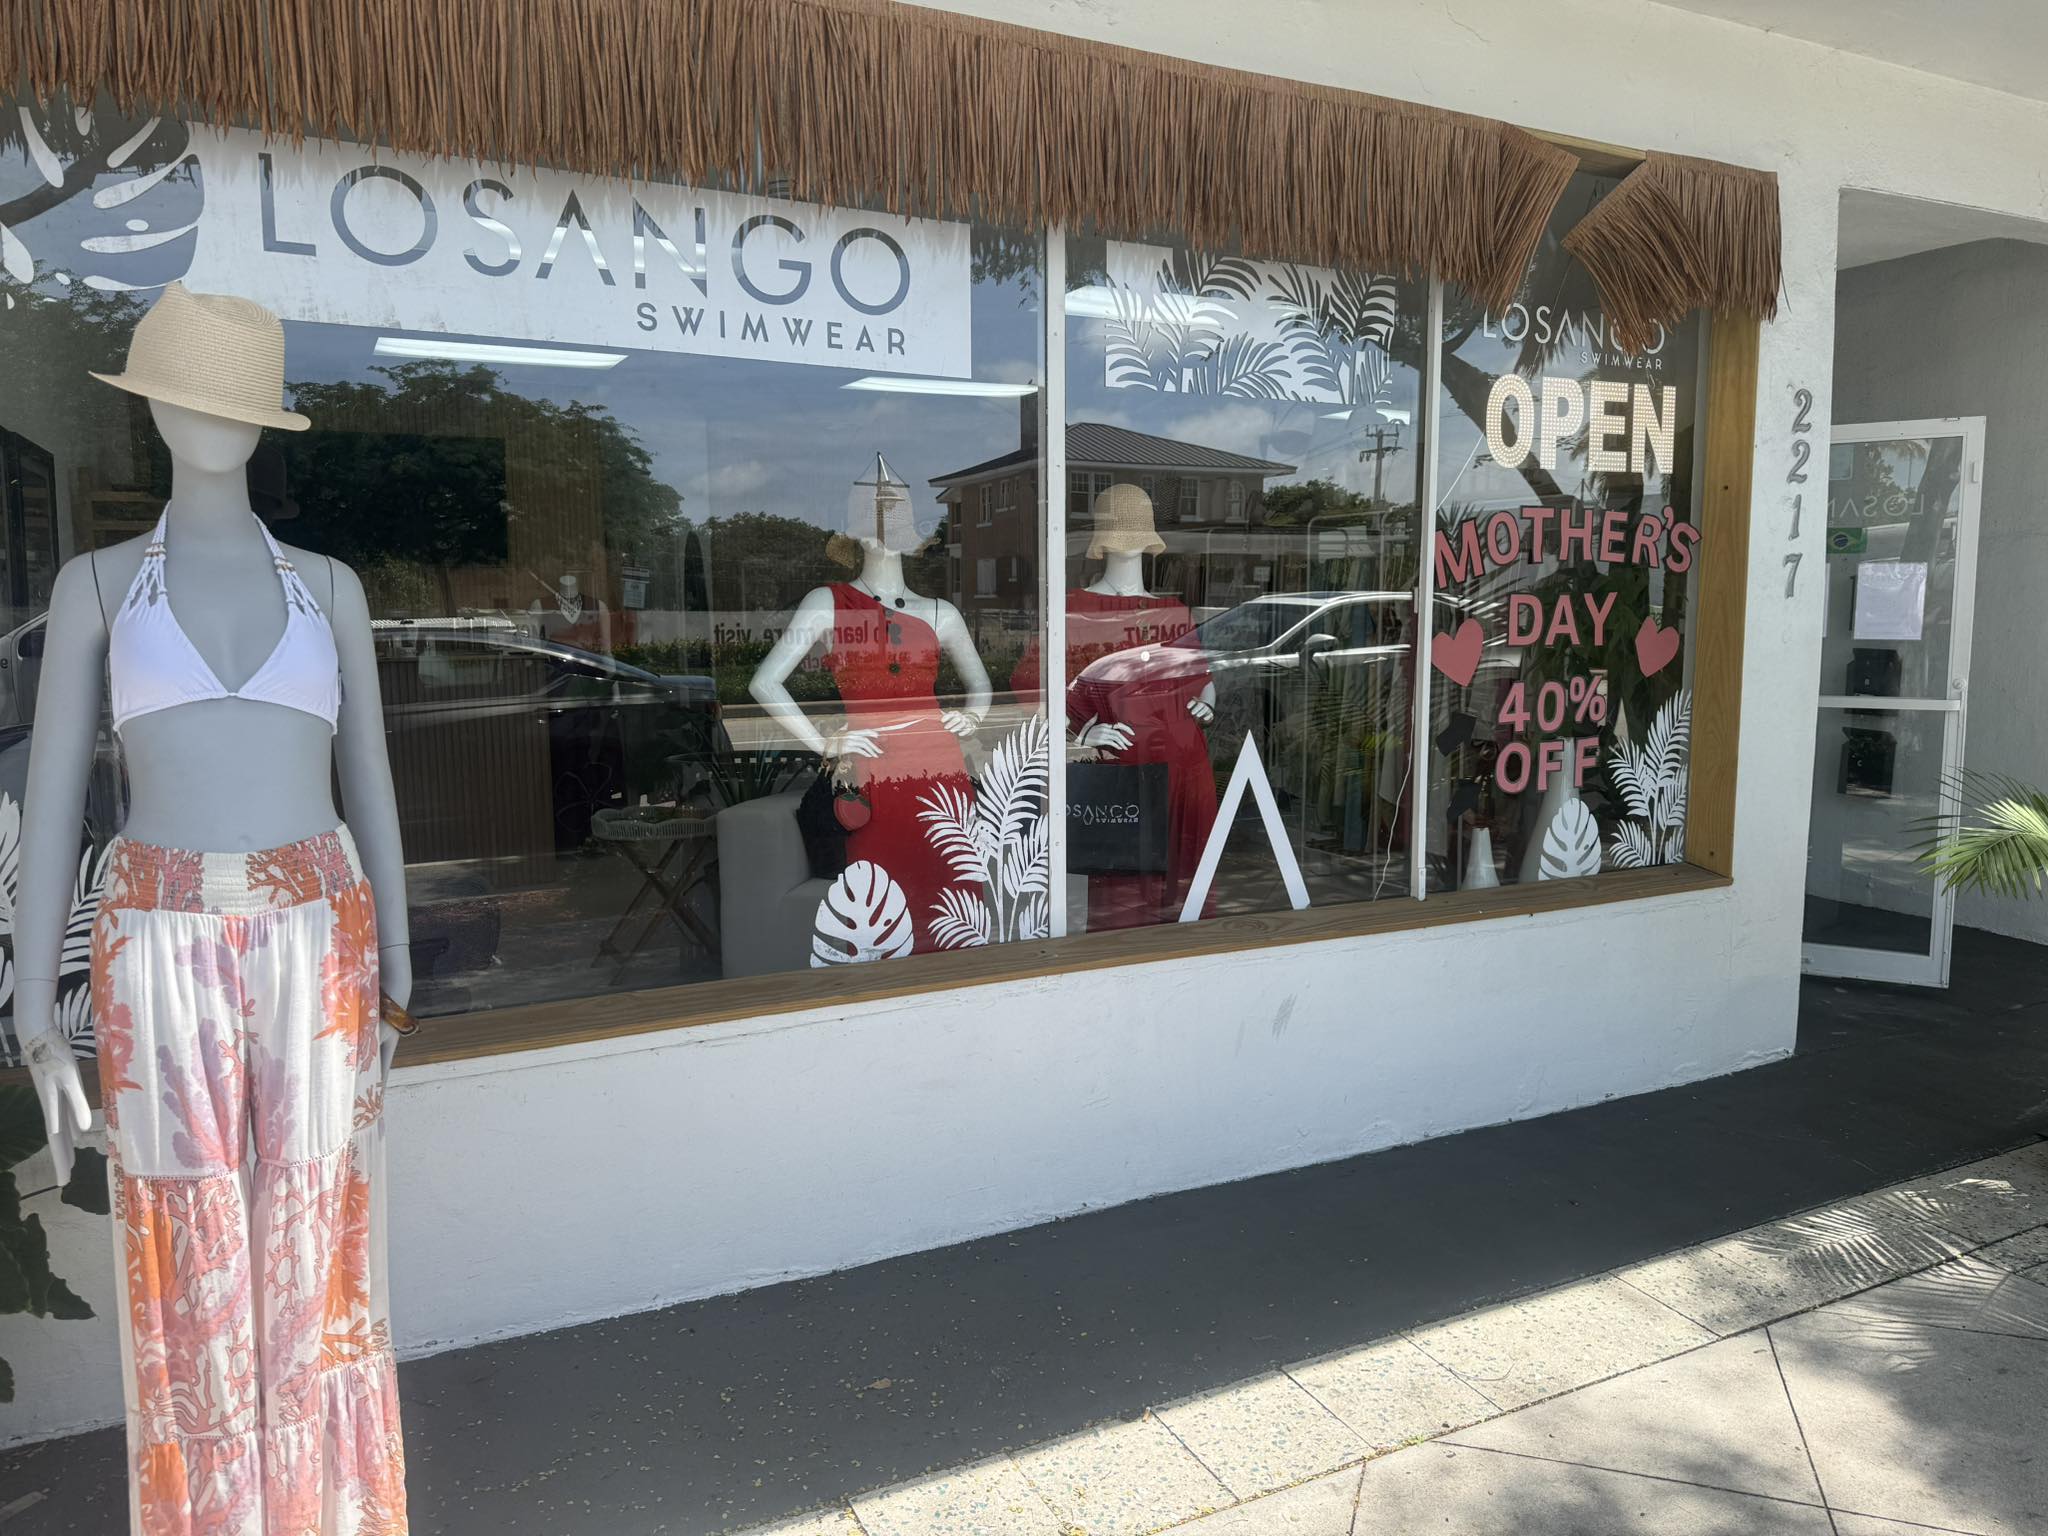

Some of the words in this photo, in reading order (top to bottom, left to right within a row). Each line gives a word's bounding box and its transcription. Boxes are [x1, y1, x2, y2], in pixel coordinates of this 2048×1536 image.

[257, 152, 911, 316] LOSANGO
[636, 302, 906, 356] SWIMWEAR
[1581, 351, 1663, 370] SWIMWEAR
[1485, 373, 1677, 474] OPEN
[1782, 388, 1813, 599] 2217
[1434, 505, 1702, 589] MOTHER'S
[1507, 591, 1618, 647] DAY
[1498, 675, 1608, 733] 40%
[1495, 736, 1600, 794] OFF
